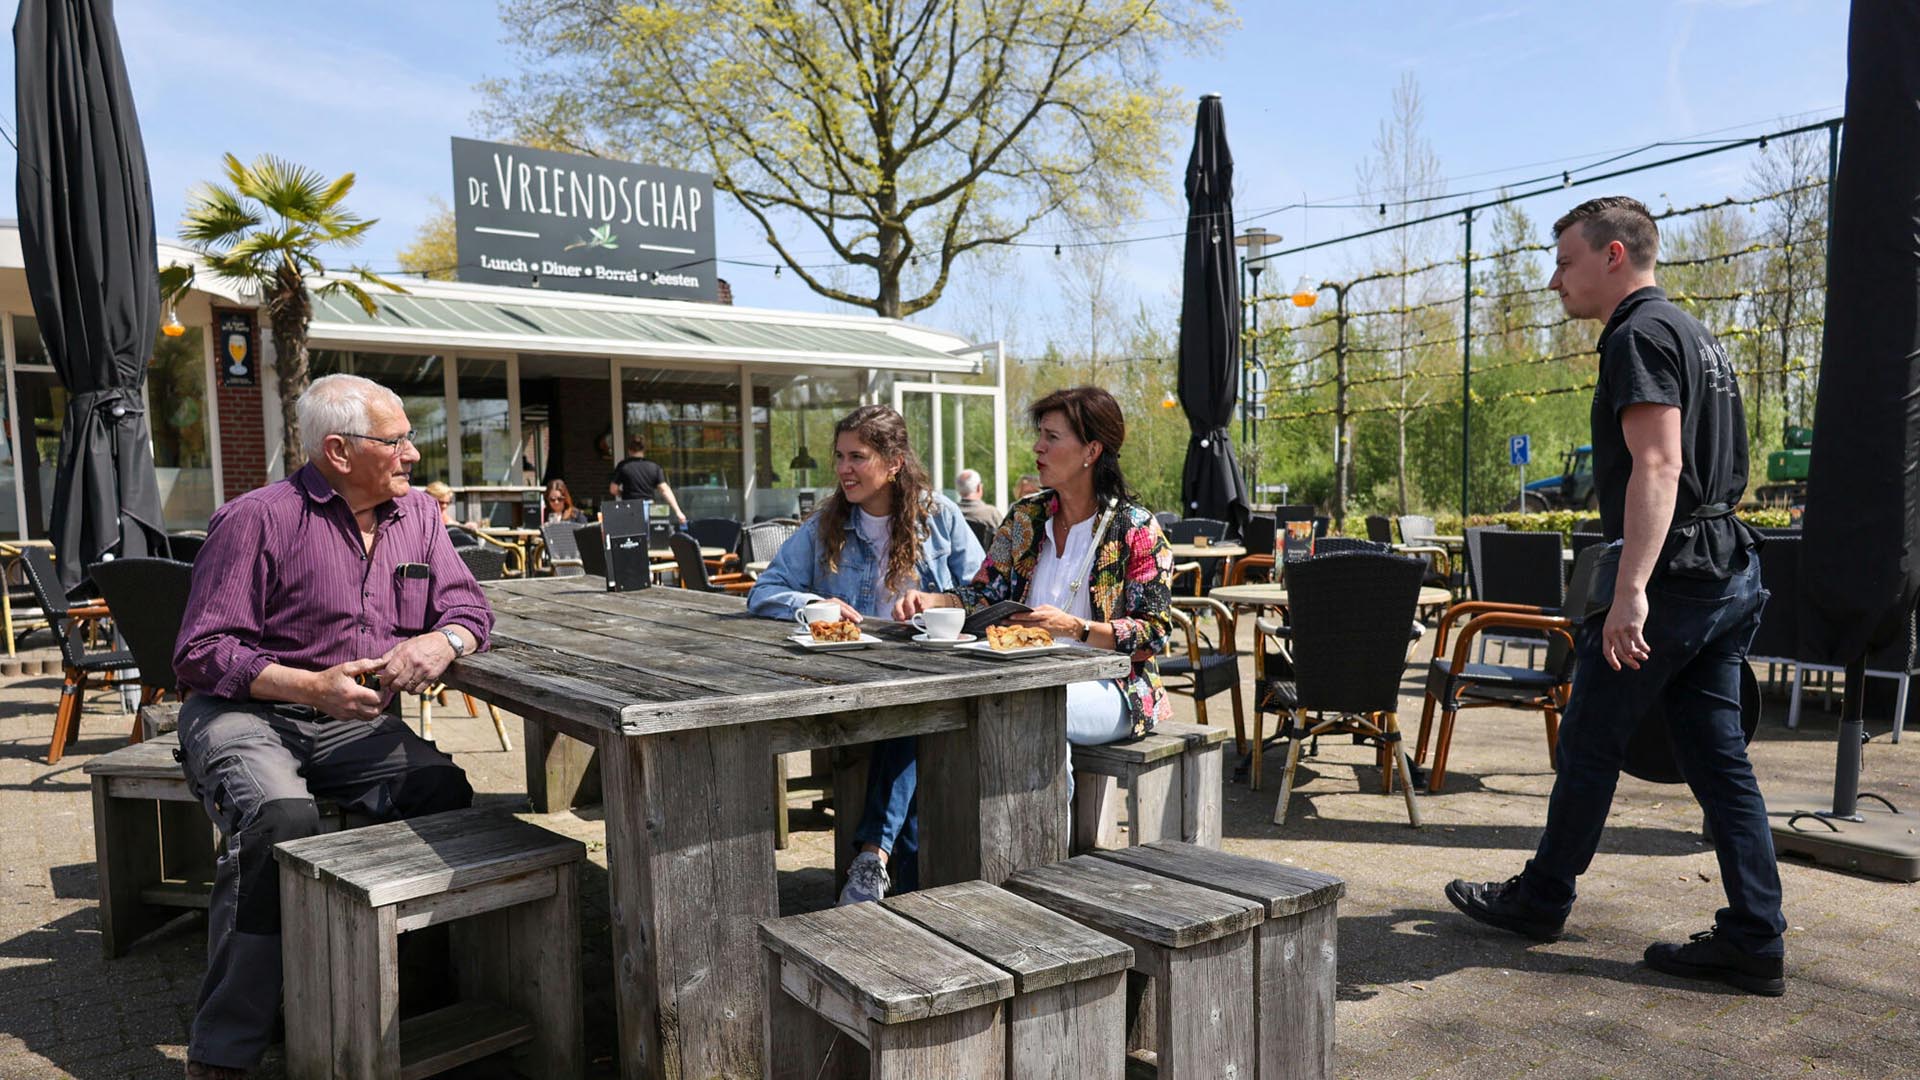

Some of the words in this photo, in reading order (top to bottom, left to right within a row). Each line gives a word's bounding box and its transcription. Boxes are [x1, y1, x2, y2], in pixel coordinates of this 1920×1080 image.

[468, 177, 490, 208] DE
[493, 152, 701, 233] VRIENDSCHAP
[480, 254, 528, 273] Lunch
[542, 260, 582, 277] Diner
[595, 265, 638, 283] Borrel
[1514, 438, 1525, 454] P
